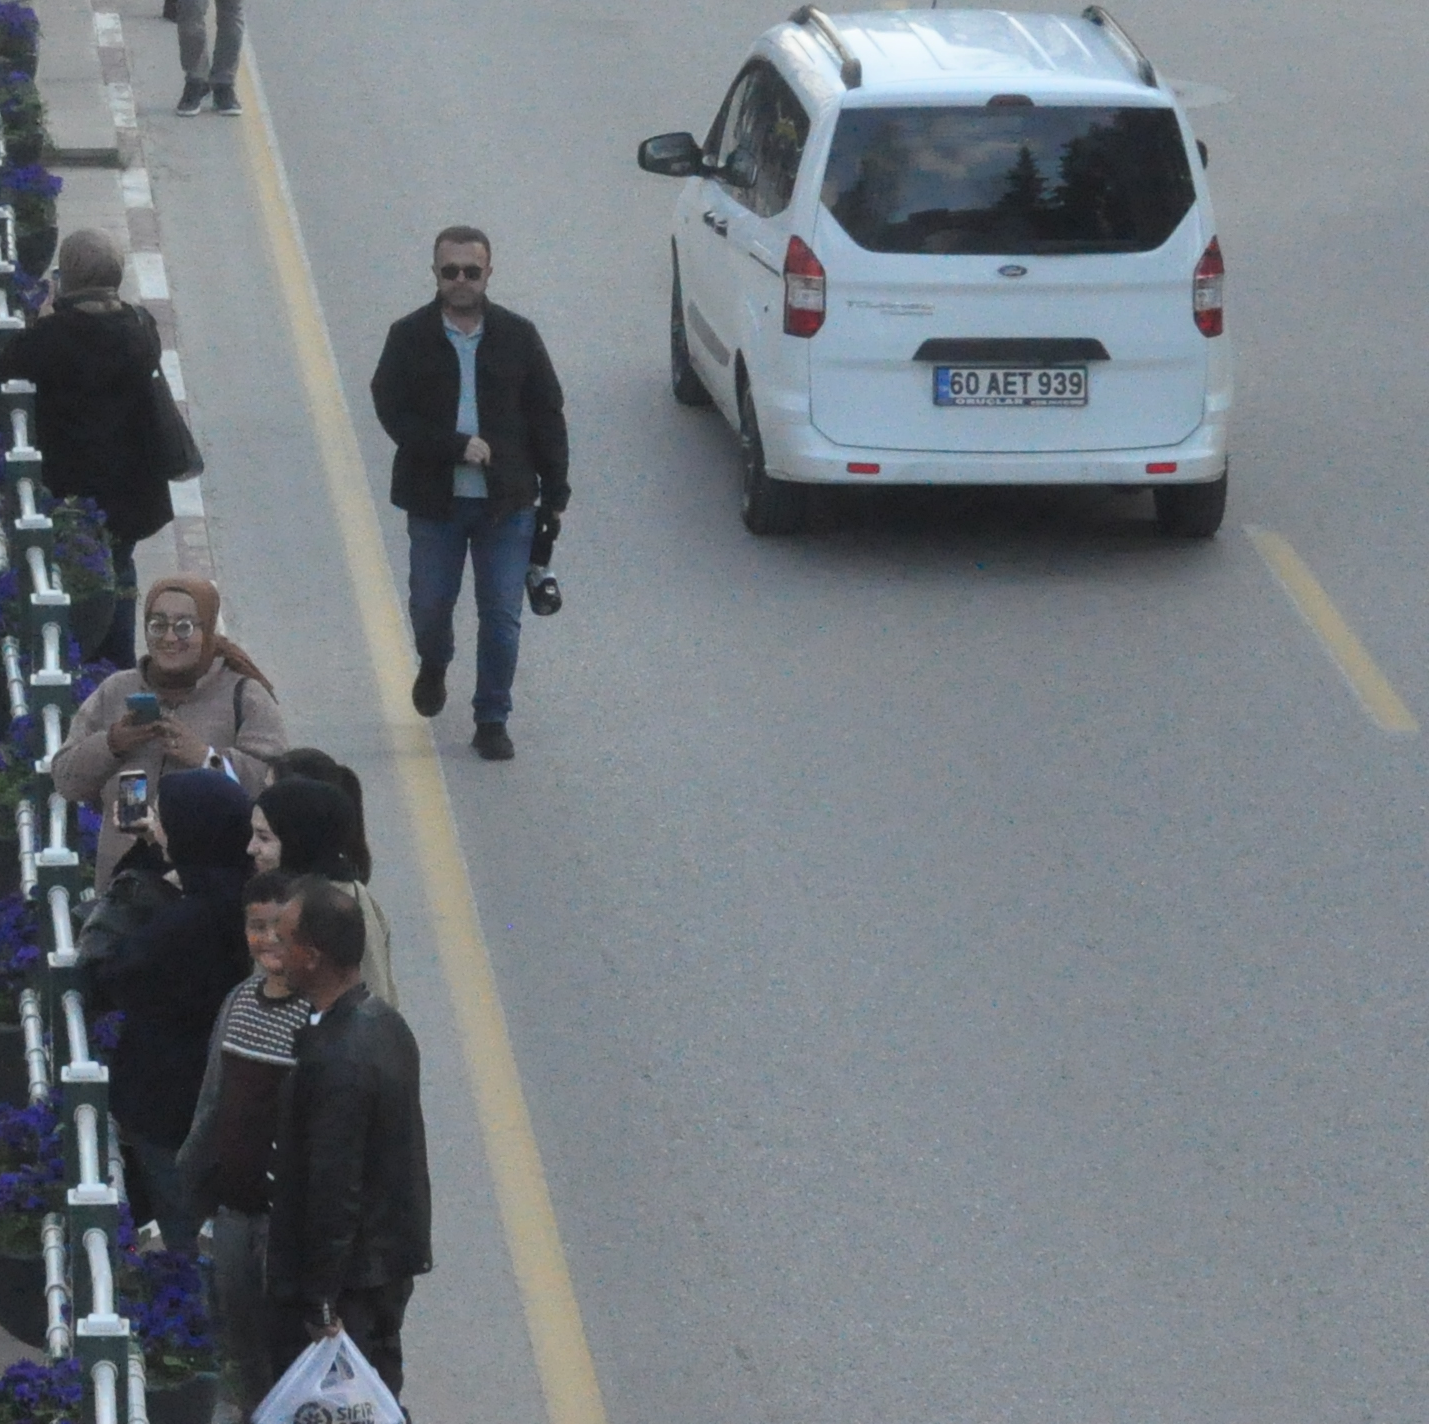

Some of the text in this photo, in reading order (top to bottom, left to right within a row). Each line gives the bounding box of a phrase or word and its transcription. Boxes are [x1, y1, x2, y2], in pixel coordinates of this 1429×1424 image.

[950, 371, 1083, 396] 60 AET 939
